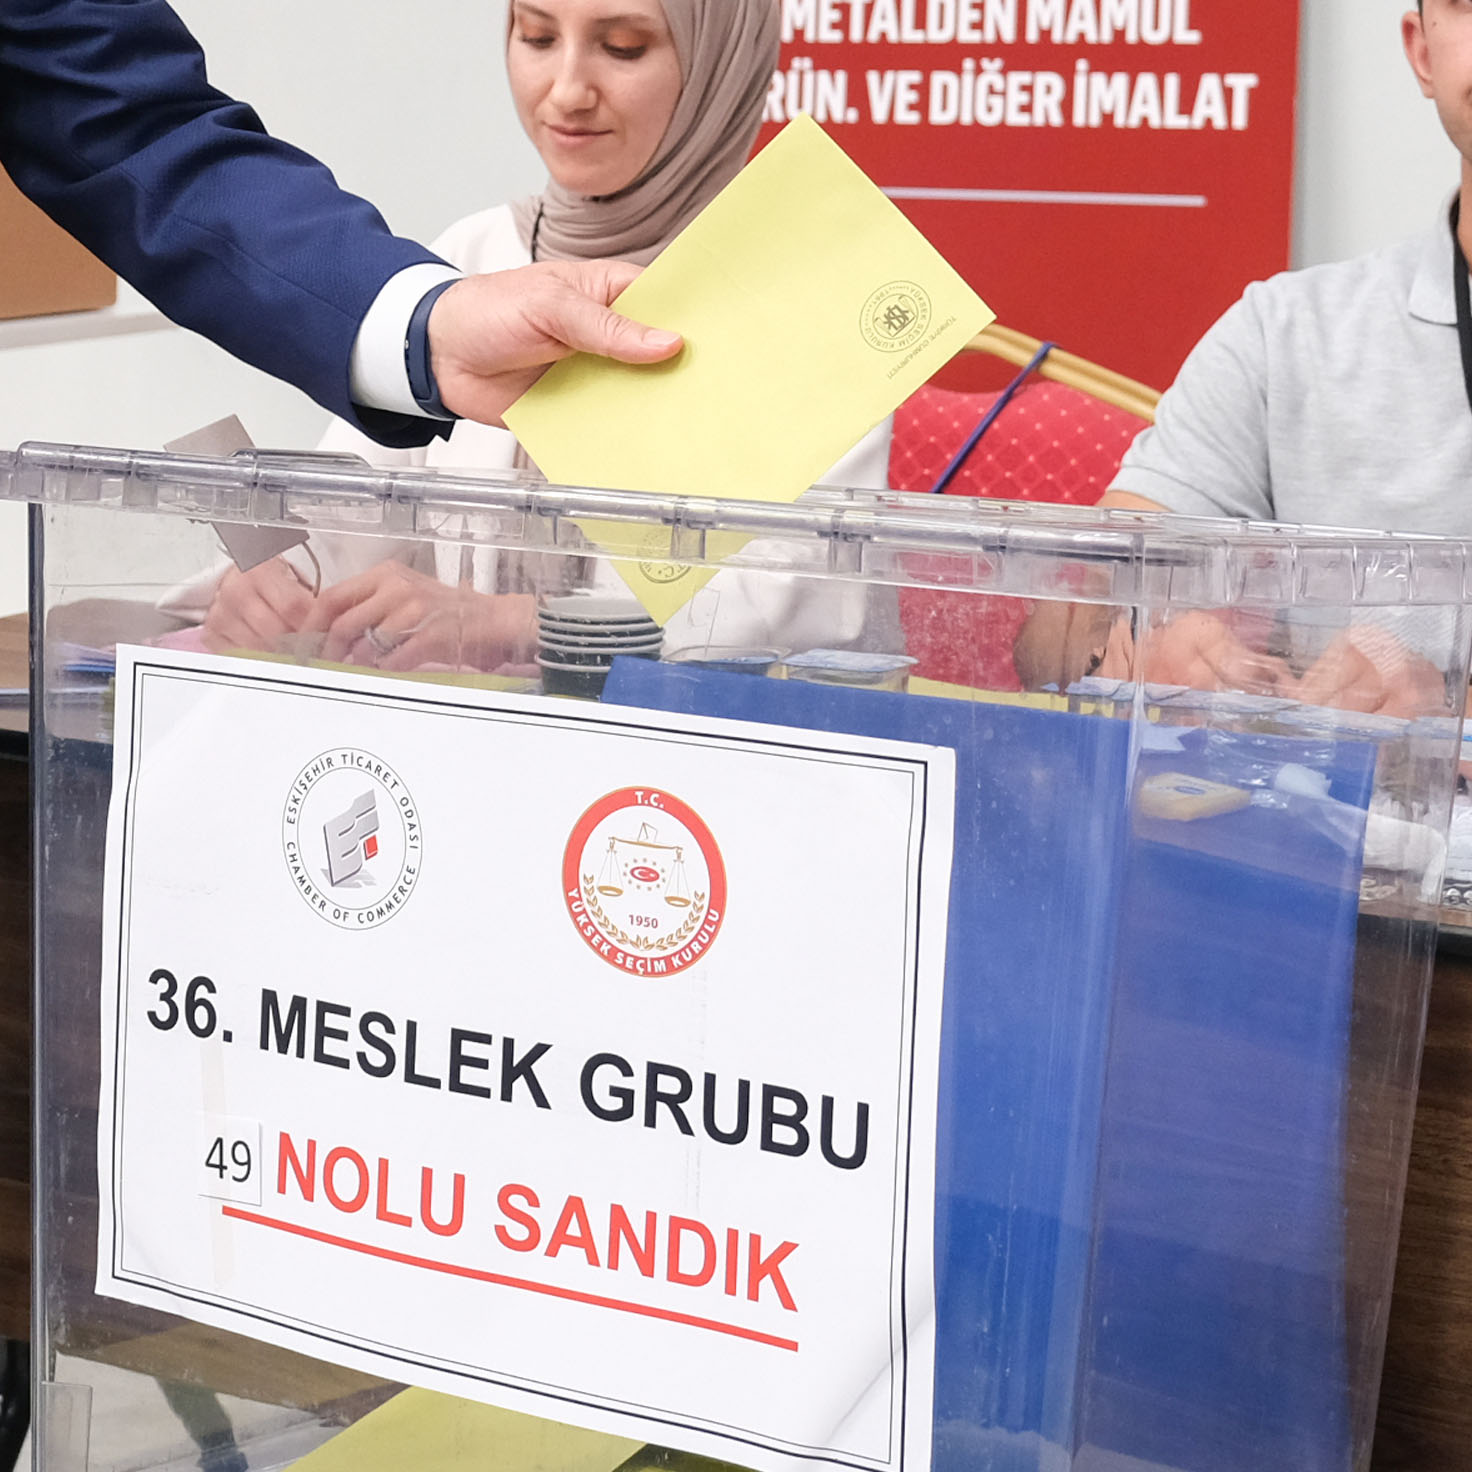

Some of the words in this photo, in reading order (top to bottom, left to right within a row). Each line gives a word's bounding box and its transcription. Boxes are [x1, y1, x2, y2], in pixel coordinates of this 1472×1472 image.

[761, 56, 860, 123] RÜN.
[865, 70, 924, 126] VE
[928, 58, 1066, 128] DİĞER
[1072, 58, 1259, 130] İMALAT
[286, 757, 334, 825] ESKİŞEHİR
[341, 752, 399, 790] TİCARET
[399, 796, 419, 850] ODASI
[635, 791, 664, 809] T.C.
[286, 841, 327, 911] CHAMBER
[333, 908, 349, 922] OF
[357, 865, 416, 924] COMMERCE
[628, 914, 658, 929] 1950
[567, 887, 611, 956] YÜKSEK
[614, 952, 667, 975] SEÇİM
[671, 908, 720, 968] KURULU
[146, 968, 233, 1044] 36.
[258, 987, 553, 1111] MESLEK
[579, 1052, 870, 1171] GRUBU
[204, 1134, 253, 1184] 49
[276, 1130, 466, 1239] NOLU
[493, 1182, 800, 1314] SANDIK
